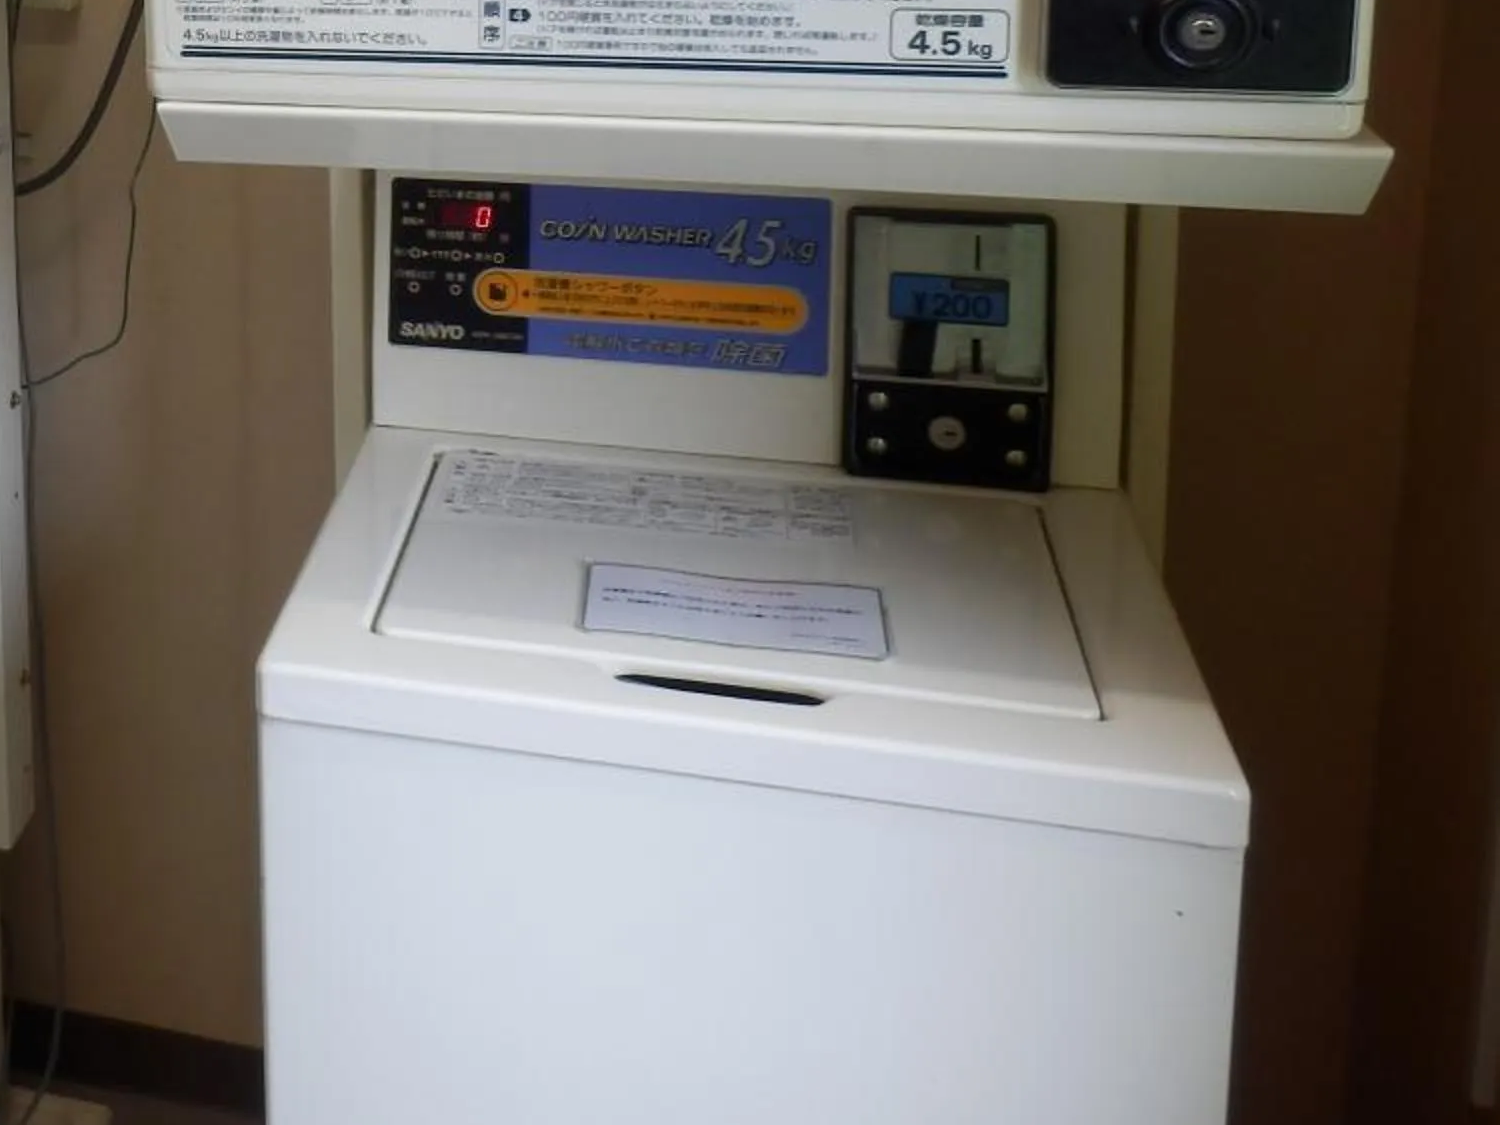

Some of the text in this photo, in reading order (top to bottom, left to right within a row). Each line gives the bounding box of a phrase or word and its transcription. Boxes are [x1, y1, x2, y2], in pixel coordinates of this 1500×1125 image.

[908, 30, 994, 59] 4.5 kg
[475, 206, 492, 228] 0
[613, 223, 712, 246] WASHER
[400, 321, 465, 341] SANYO
